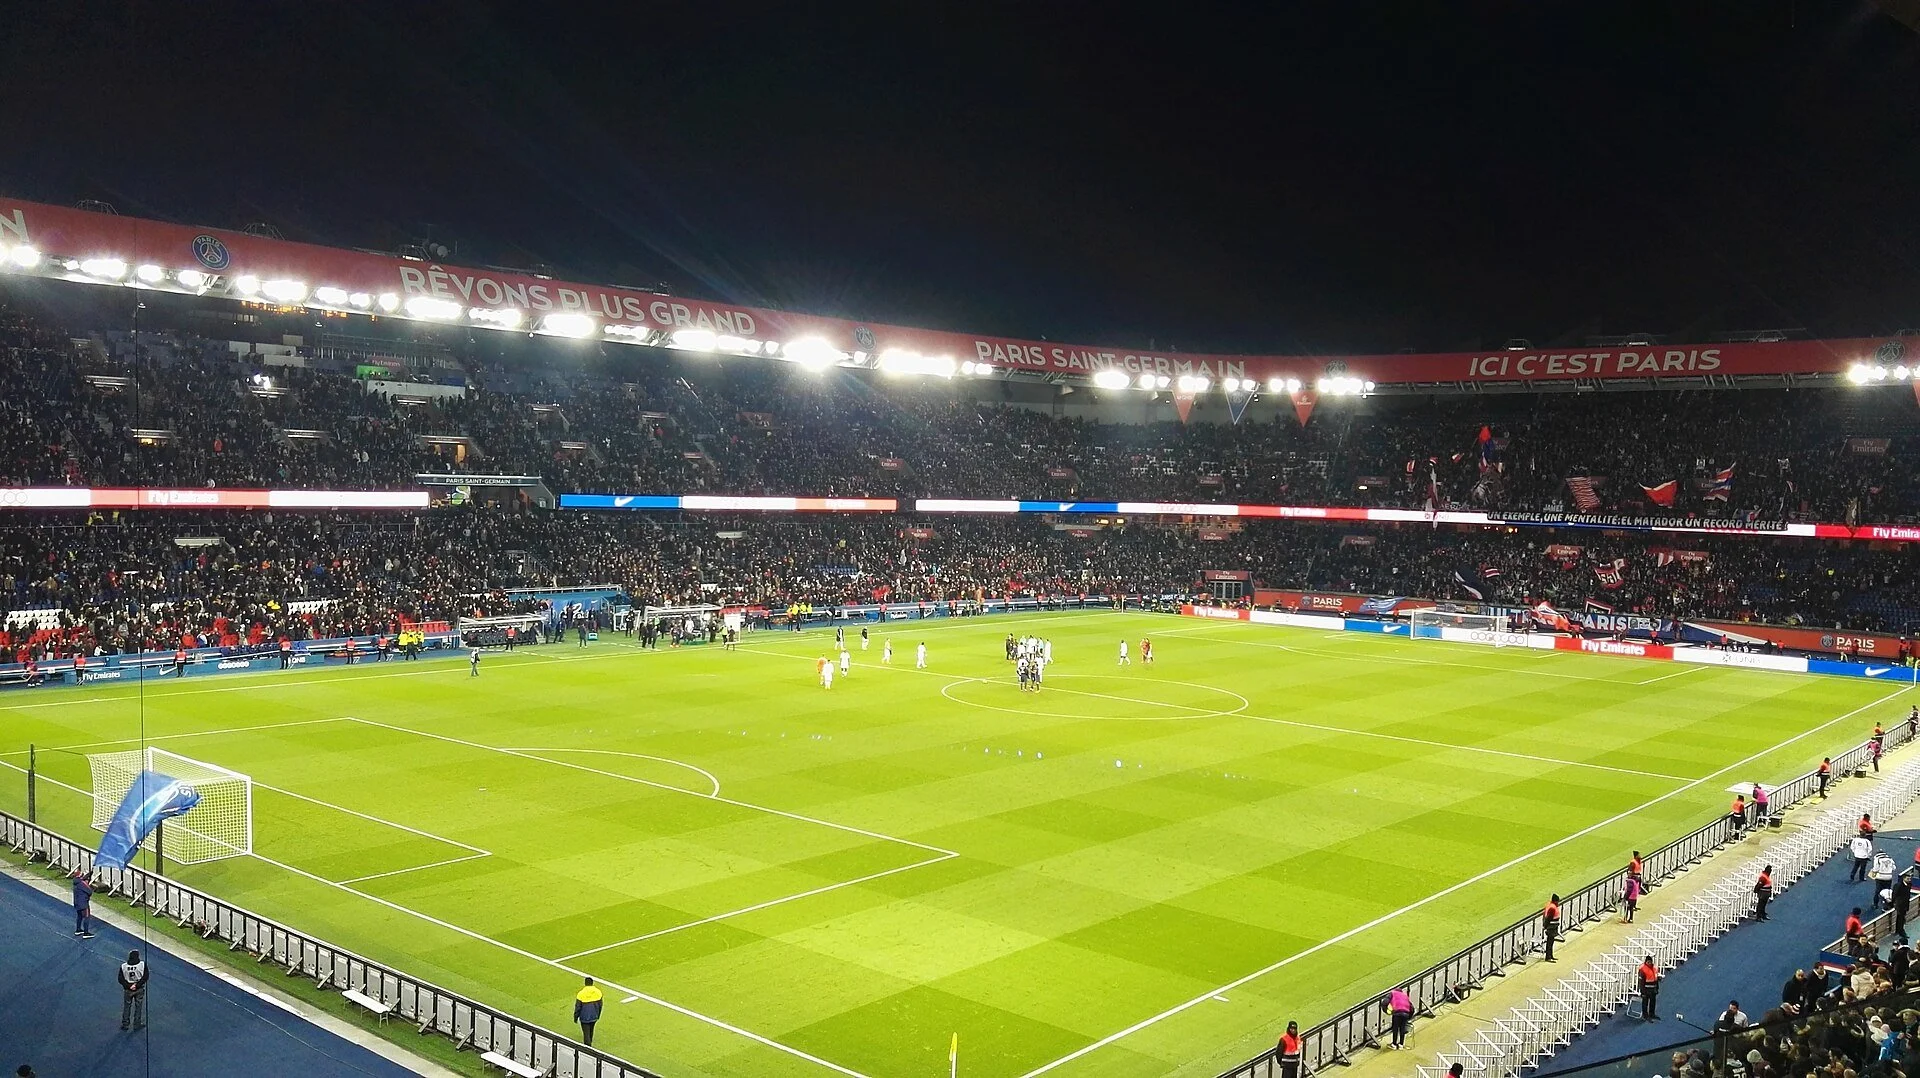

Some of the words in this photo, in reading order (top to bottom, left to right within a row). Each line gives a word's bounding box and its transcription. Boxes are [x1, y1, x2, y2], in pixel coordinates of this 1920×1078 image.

[399, 265, 553, 311] RÊVONS
[557, 288, 645, 322] PLUS
[650, 301, 756, 335] GRAND
[975, 341, 1046, 366] PARIS
[1051, 348, 1245, 378] SAINT-GERMAIN
[1469, 357, 1509, 376] ICI
[1517, 353, 1611, 375] C'EST
[1617, 349, 1721, 372] PARIS
[1634, 516, 1683, 527] MATADOR
[1684, 517, 1700, 527] UN
[1703, 518, 1743, 529] RECORD
[1872, 527, 1890, 538] Fly
[1891, 529, 1920, 538] Emira
[1313, 597, 1342, 606] PARIS
[1581, 640, 1599, 653] Fly
[1600, 641, 1646, 656] Emirates
[1836, 636, 1875, 649] PARIS
[94, 672, 120, 680] Emirates
